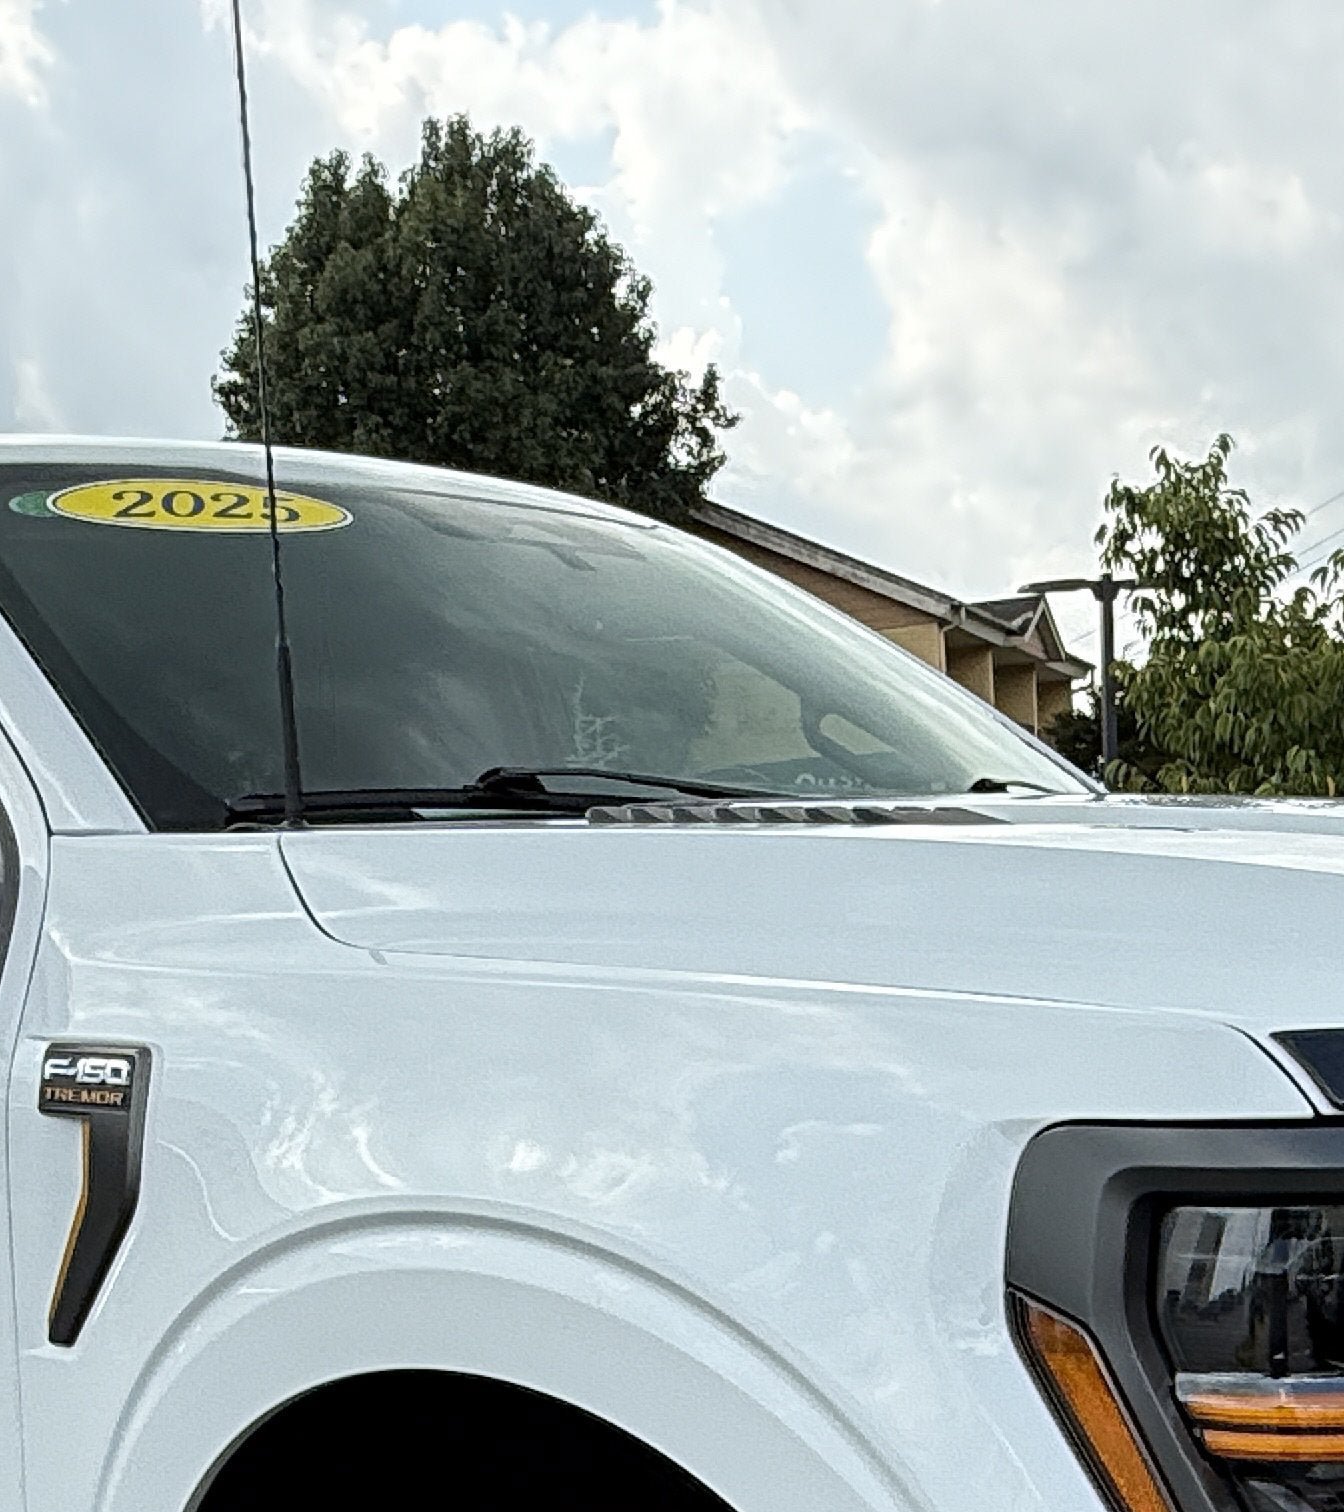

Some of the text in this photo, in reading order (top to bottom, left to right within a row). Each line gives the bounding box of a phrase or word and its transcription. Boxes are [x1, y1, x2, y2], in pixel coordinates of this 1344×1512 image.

[112, 489, 300, 523] 2025
[44, 1057, 131, 1086] F-150
[44, 1087, 124, 1106] TREMOR
